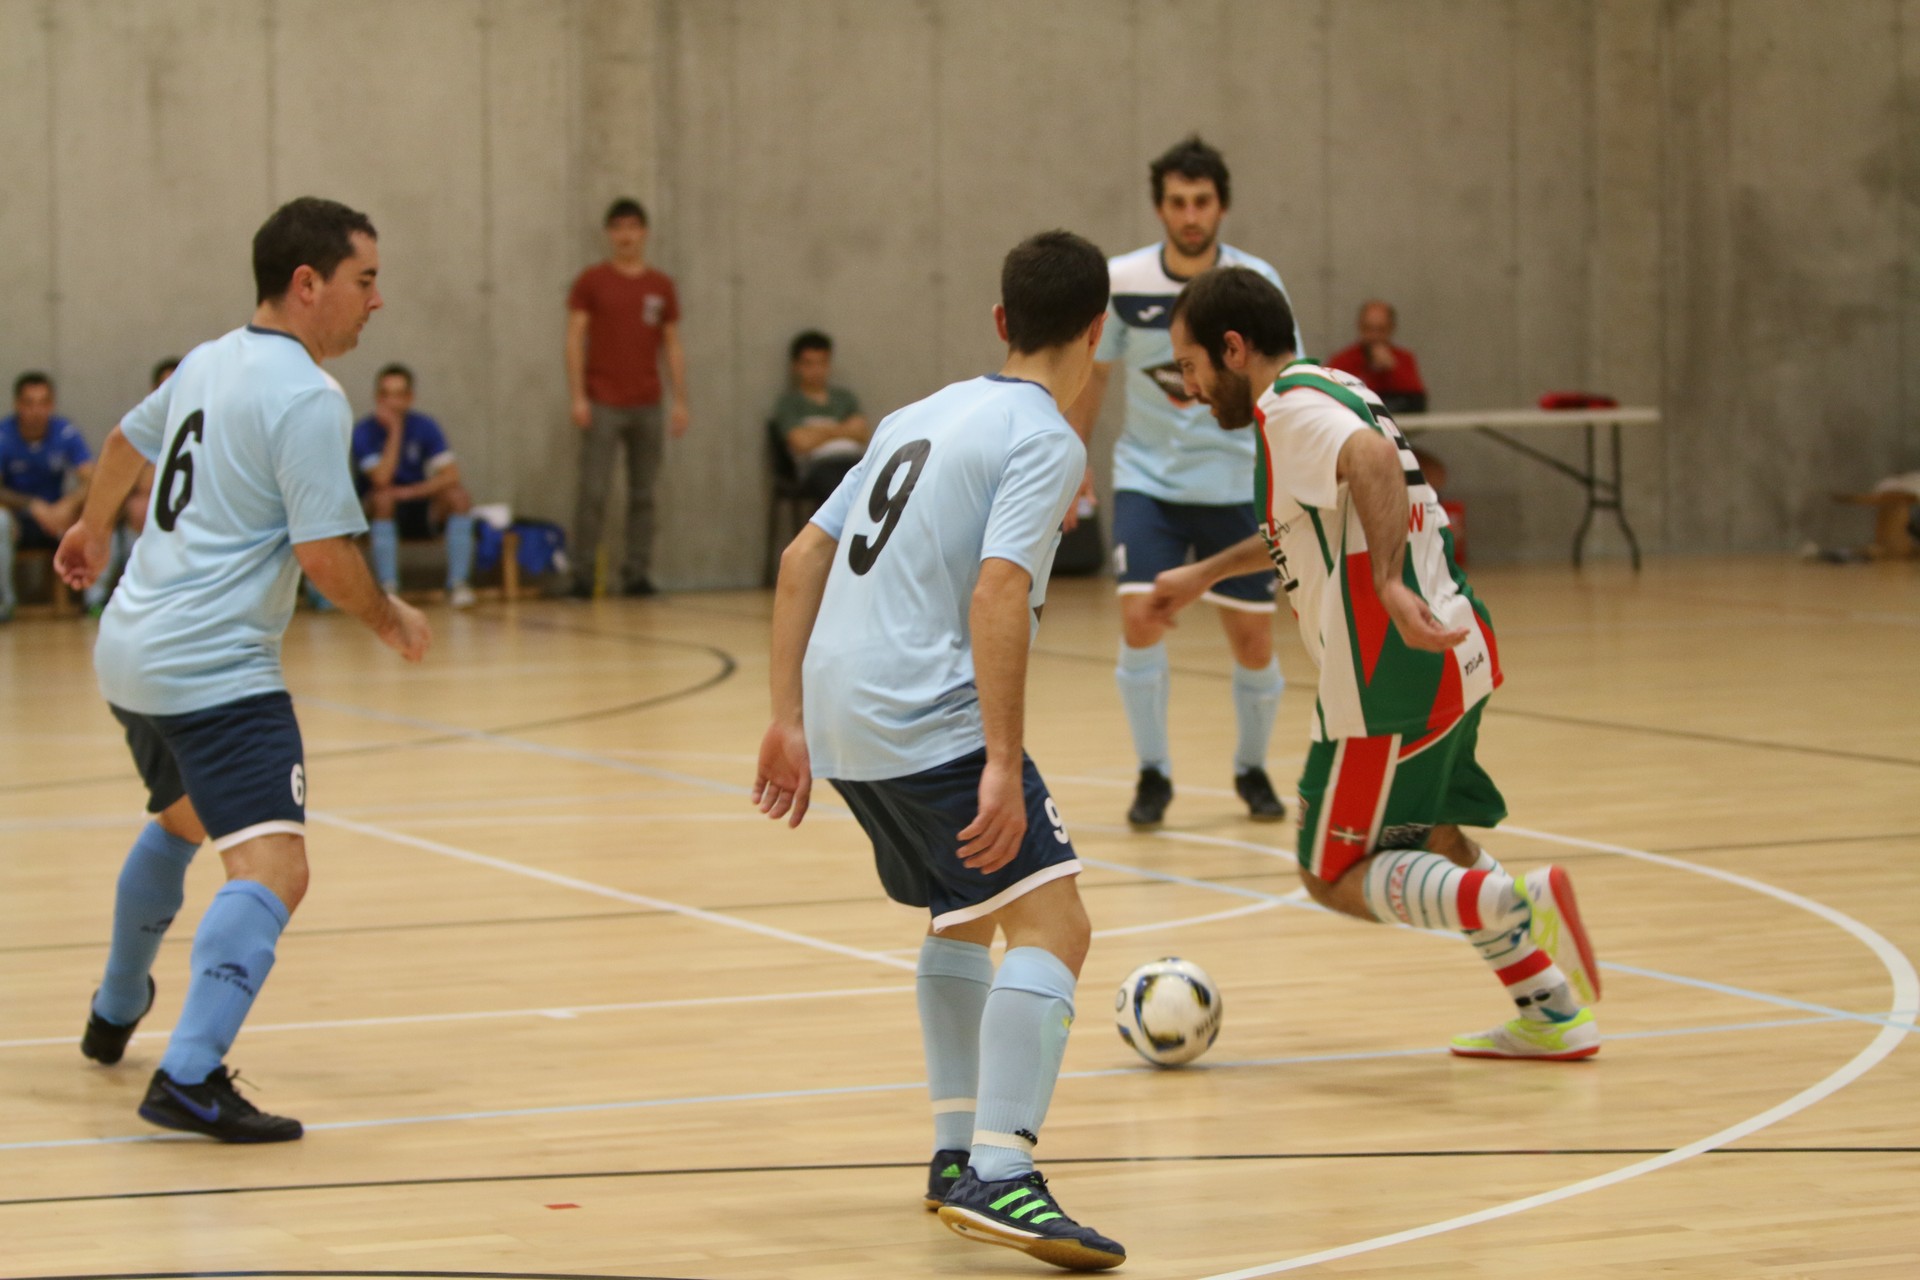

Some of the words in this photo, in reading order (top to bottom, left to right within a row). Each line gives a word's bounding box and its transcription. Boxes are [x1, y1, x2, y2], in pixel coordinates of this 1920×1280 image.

[155, 408, 204, 533] 6
[848, 438, 931, 576] 9
[290, 763, 304, 806] 6
[1044, 797, 1069, 844] 9
